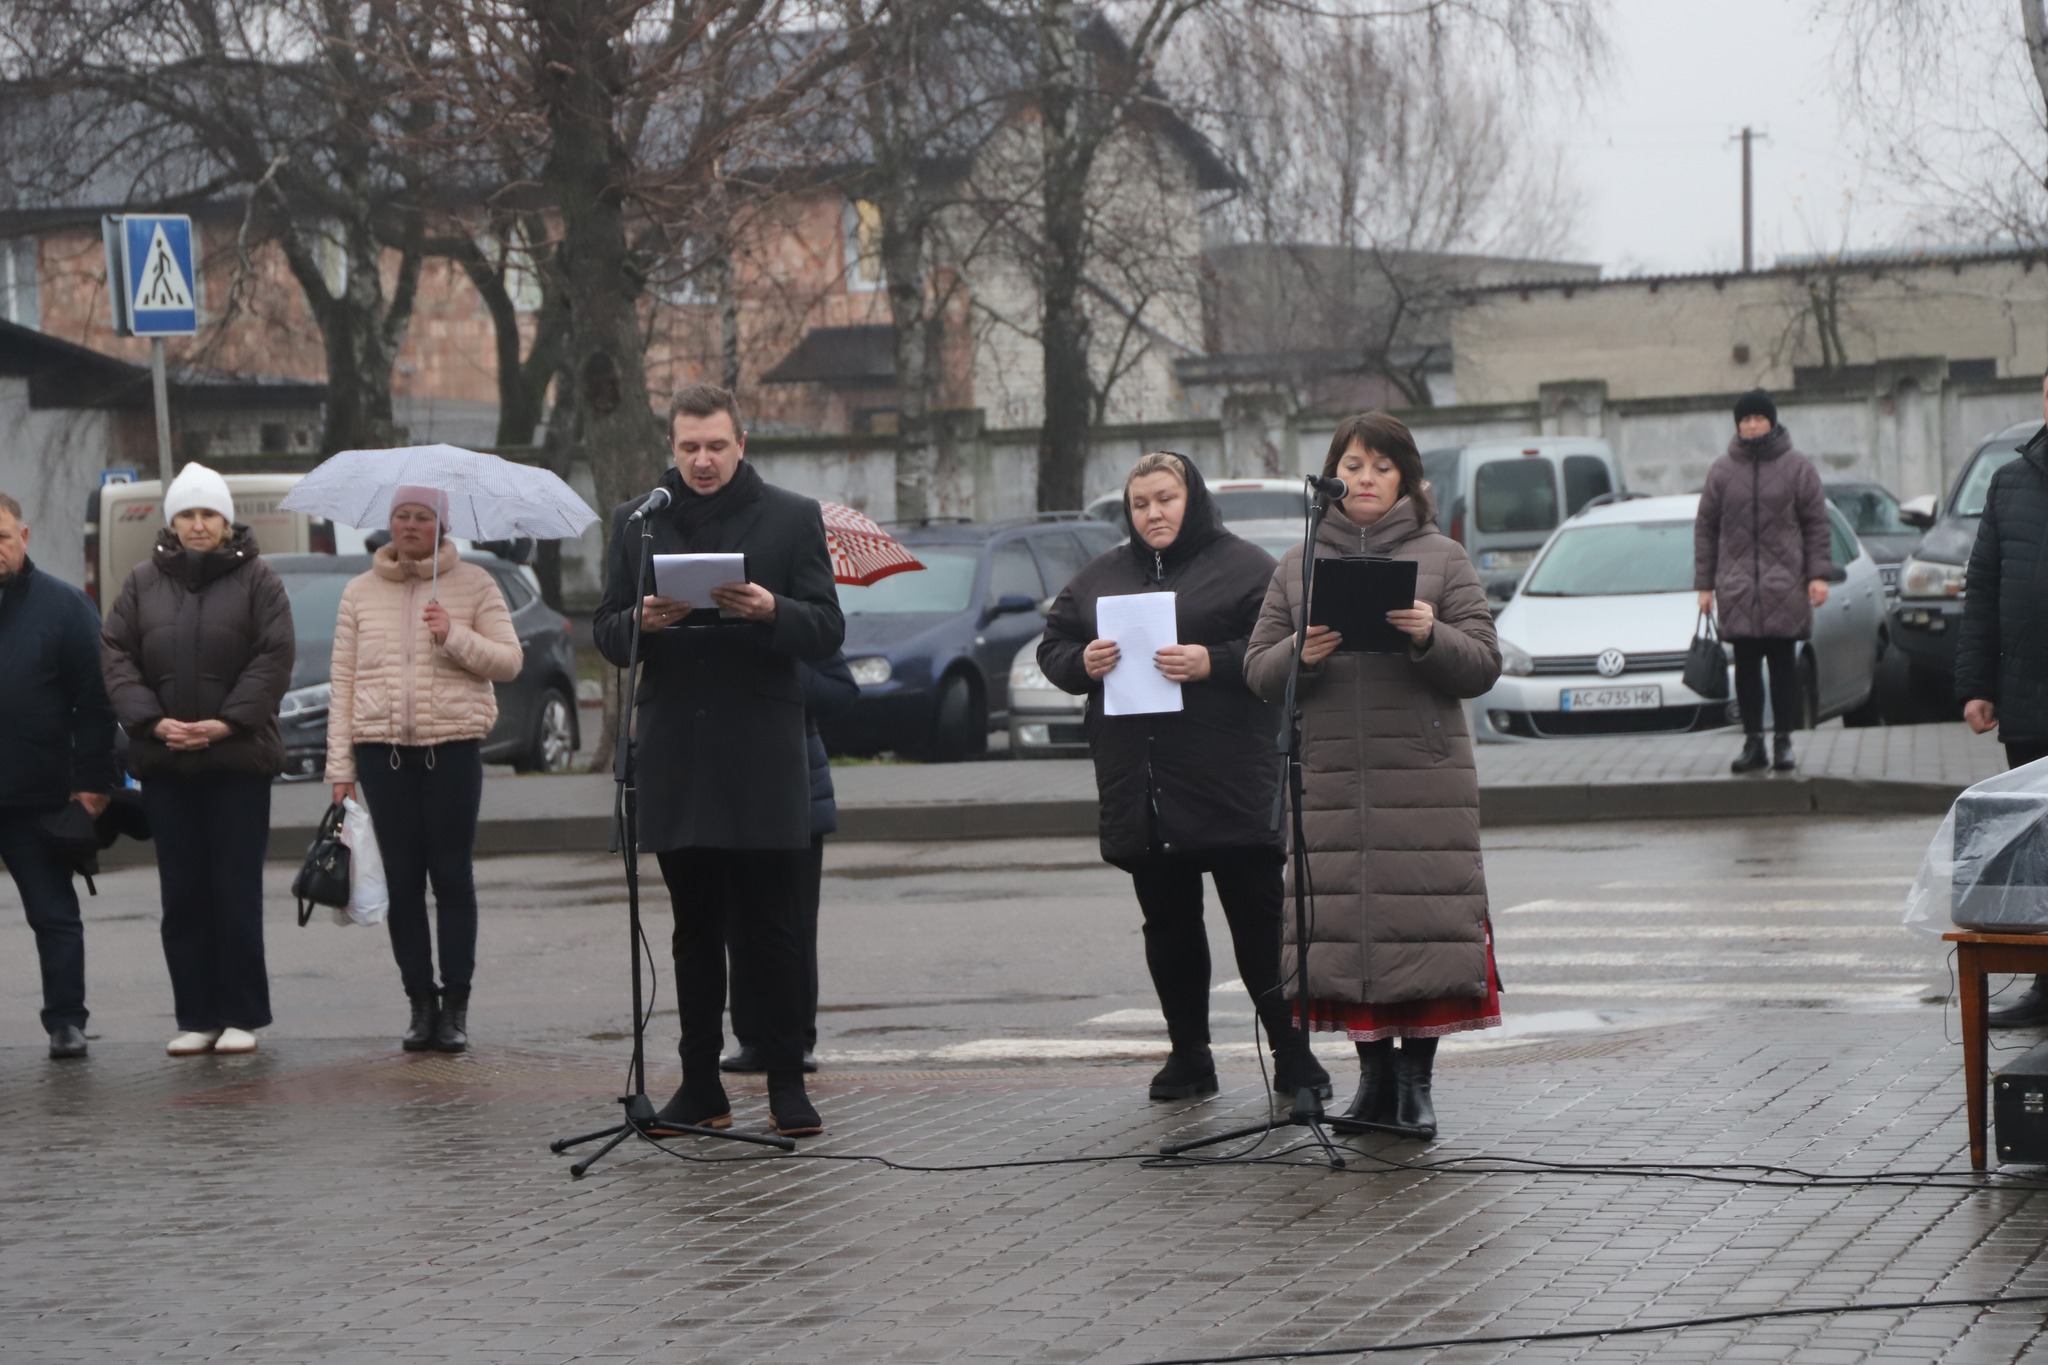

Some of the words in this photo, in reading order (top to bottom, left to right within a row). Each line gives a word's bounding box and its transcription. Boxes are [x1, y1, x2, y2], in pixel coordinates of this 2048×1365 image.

[1573, 692, 1594, 706] AC
[1597, 691, 1631, 705] 4735
[1634, 690, 1656, 704] HK
